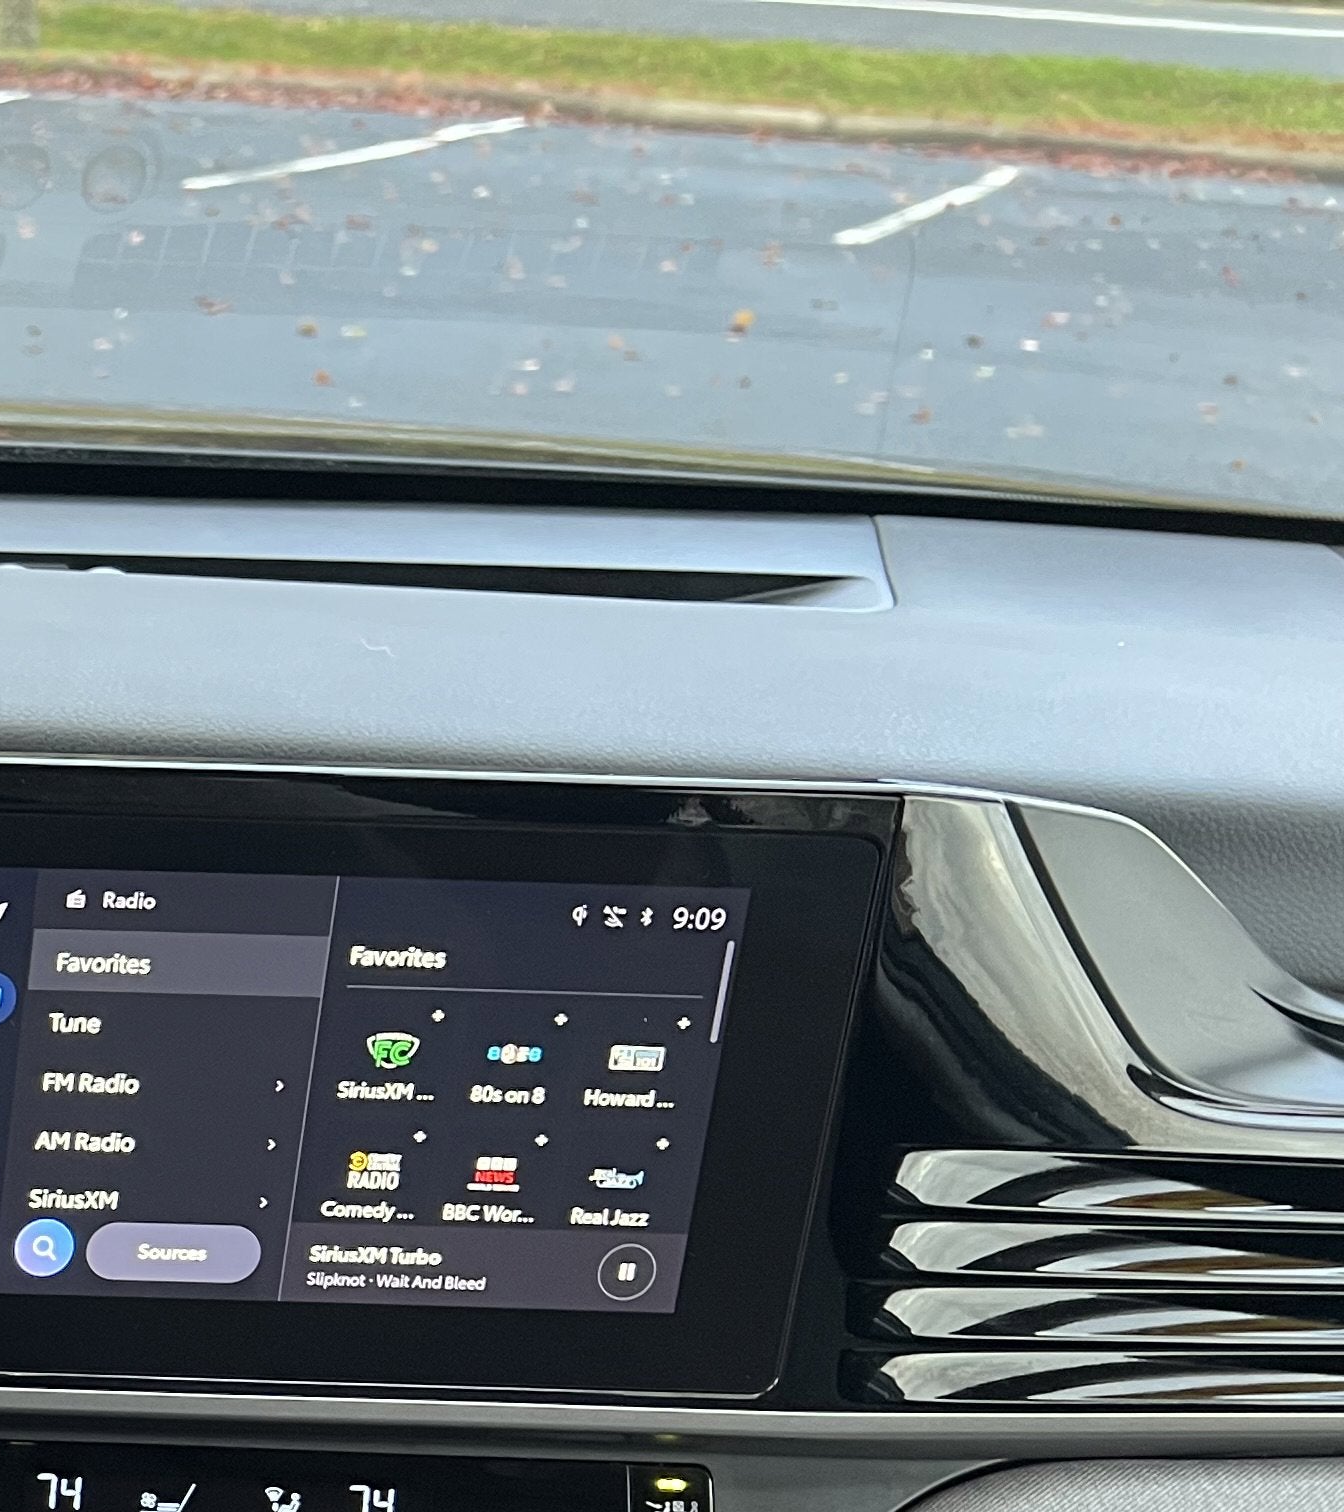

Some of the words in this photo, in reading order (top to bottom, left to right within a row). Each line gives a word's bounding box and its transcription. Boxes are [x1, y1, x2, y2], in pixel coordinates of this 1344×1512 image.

[102, 890, 156, 911] Radio
[672, 907, 727, 931] 9:09
[56, 952, 151, 975] Favorites
[349, 945, 447, 969] Favorites
[49, 1012, 101, 1034] Tune
[42, 1072, 75, 1092] FM
[78, 1072, 140, 1095] Radio
[337, 1081, 414, 1101] SiriusXM
[469, 1084, 502, 1103] 80s
[504, 1090, 529, 1104] on
[531, 1087, 546, 1105] 8
[583, 1089, 656, 1108] Howard
[34, 1131, 70, 1151] AM
[74, 1131, 136, 1154] Radio
[346, 1171, 400, 1191] RADIO
[475, 1171, 515, 1184] NEWS
[28, 1189, 119, 1211] SiriusXM
[320, 1199, 395, 1222] Comedy
[441, 1203, 479, 1221] BBC
[570, 1207, 608, 1226] Real
[610, 1209, 650, 1227] Jazz
[137, 1243, 207, 1262] Sources
[309, 1245, 387, 1264] SiriusXM
[390, 1247, 442, 1266] Turbo
[306, 1272, 366, 1289] Slipknot
[376, 1274, 411, 1288] Wait
[412, 1274, 442, 1289] And
[444, 1276, 487, 1291] Bleed
[37, 1472, 83, 1511] 74
